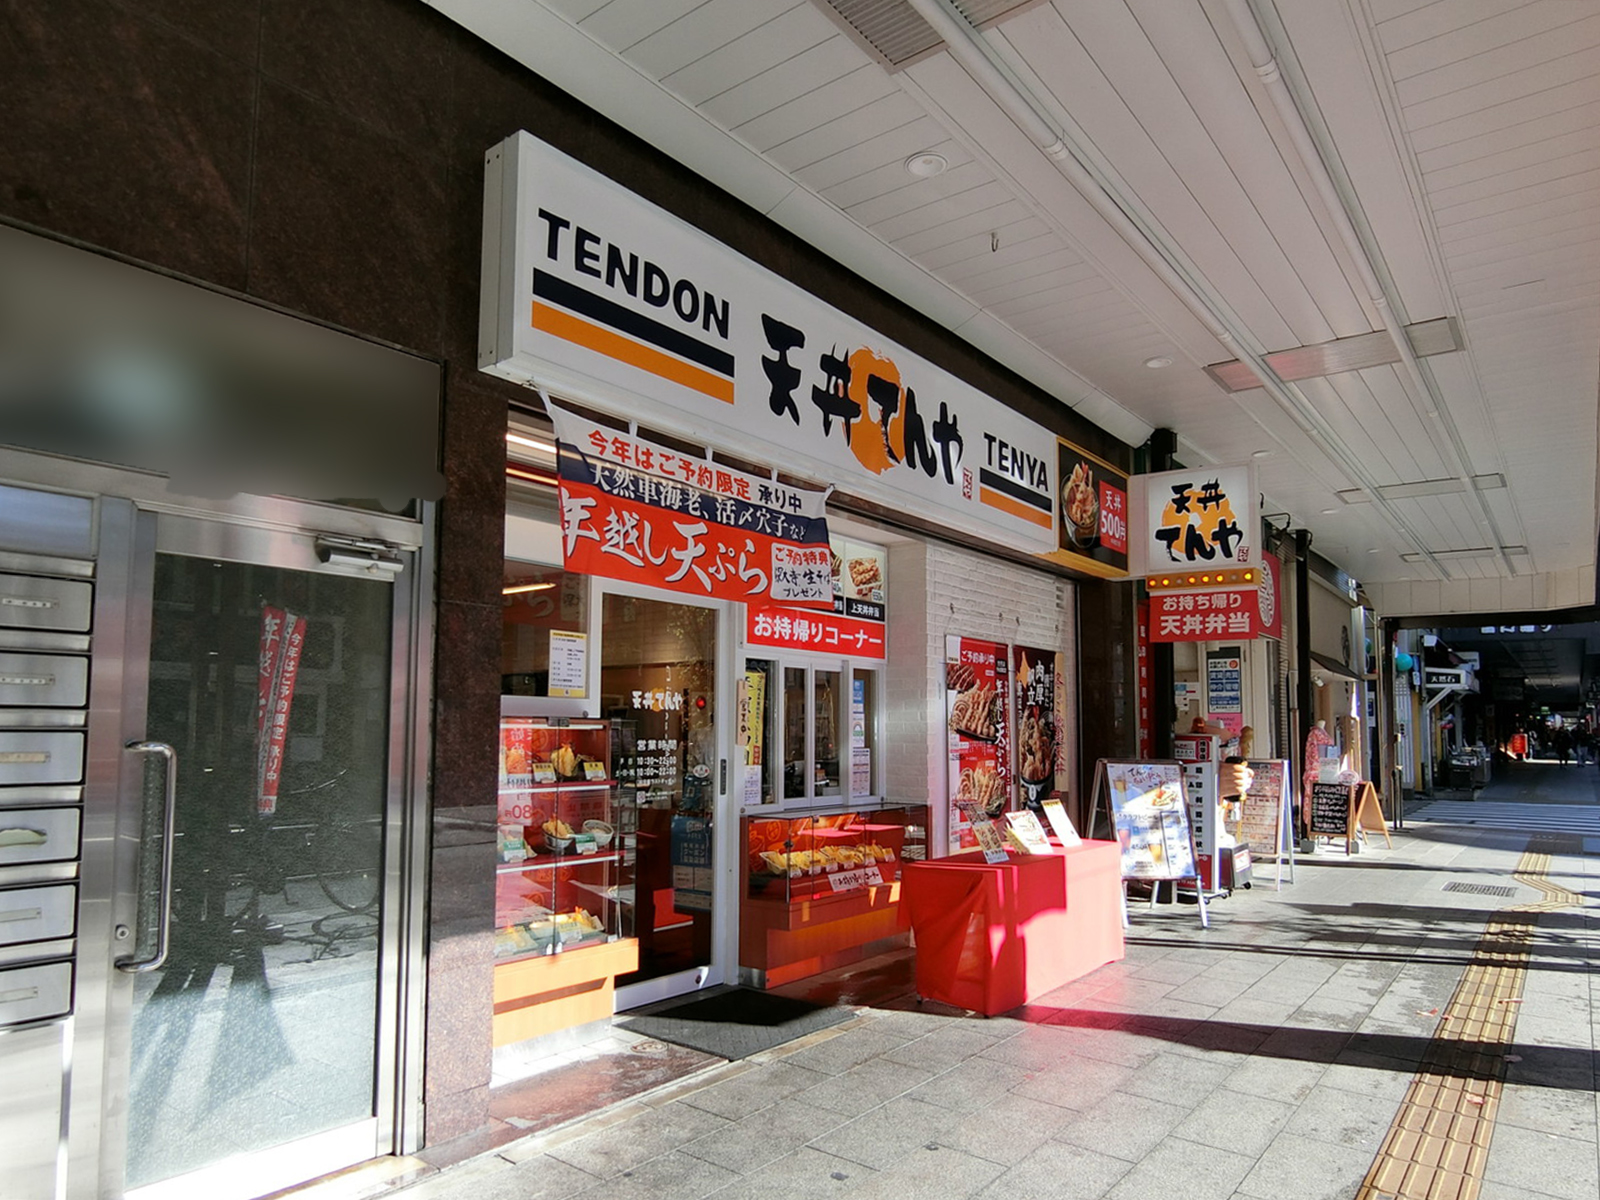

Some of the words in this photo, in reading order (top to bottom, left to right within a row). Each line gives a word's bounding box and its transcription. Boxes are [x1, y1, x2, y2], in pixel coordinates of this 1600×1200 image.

[538, 207, 730, 340] TENDON
[761, 312, 965, 486] 天丼てんや
[588, 429, 752, 502] 今年はご予約限定
[758, 484, 803, 514] 承り中
[983, 431, 1050, 493] TENYA
[1105, 489, 1122, 513] 天丼
[1171, 477, 1226, 514] 天丼
[561, 486, 769, 596] 年越し天ぷら
[1100, 510, 1127, 542] 500円
[1155, 518, 1243, 563] てんや
[775, 546, 829, 567] ご予約特典
[783, 587, 824, 598] プレゼント
[1162, 593, 1243, 611] お持ち帰り
[753, 613, 883, 649] お持帰りコーナー
[1159, 612, 1250, 636] 天丼弁当
[632, 690, 684, 712] 天丼てんや
